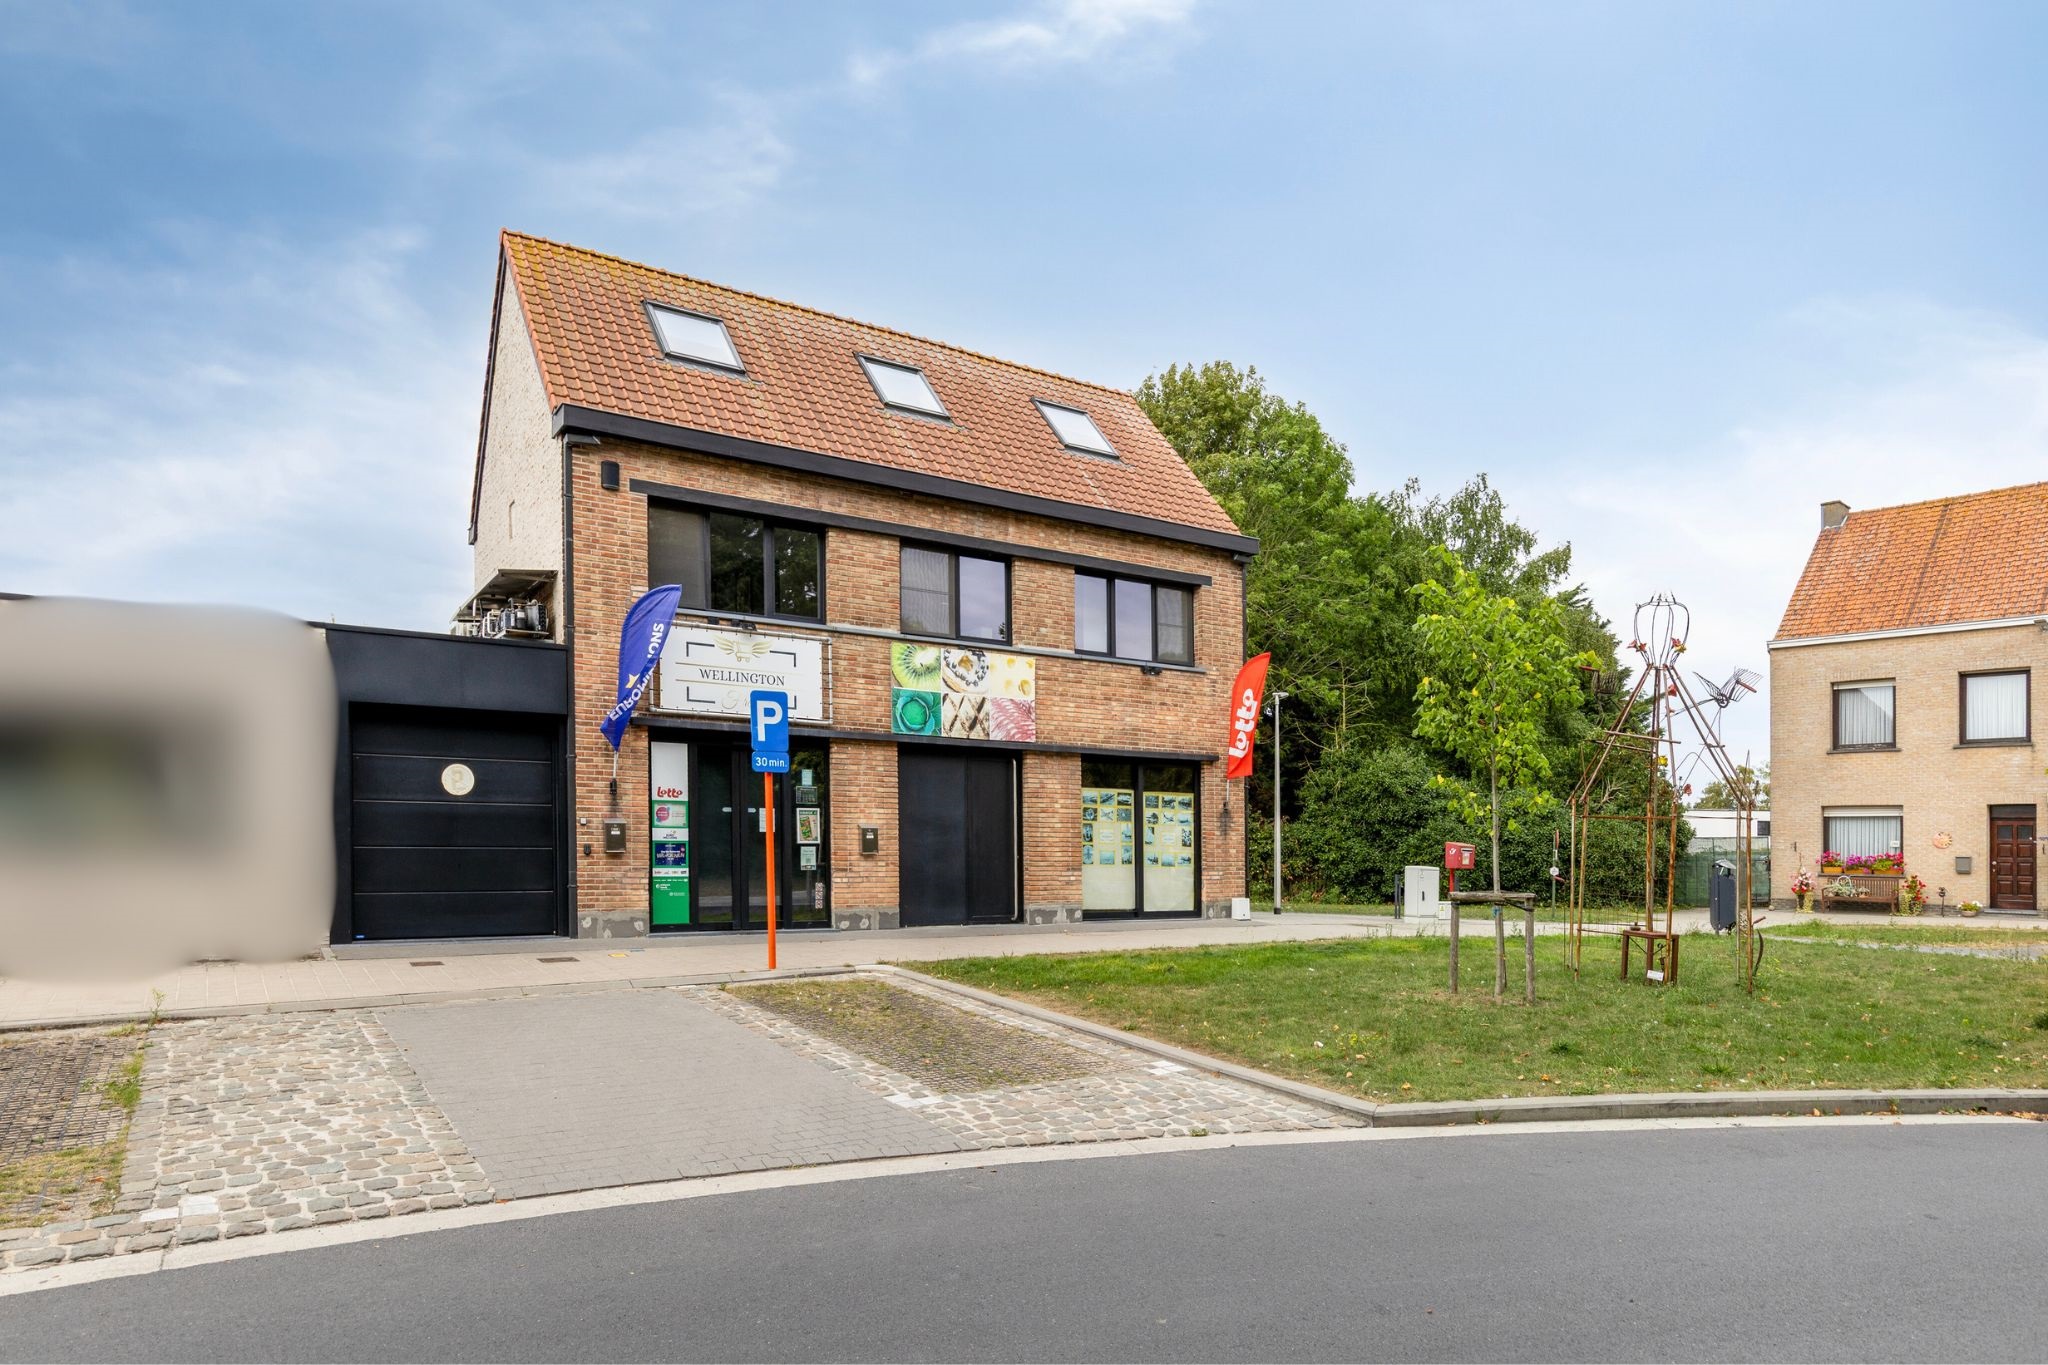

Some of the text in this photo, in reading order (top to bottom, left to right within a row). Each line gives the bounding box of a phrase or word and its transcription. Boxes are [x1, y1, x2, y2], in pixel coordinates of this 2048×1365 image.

[699, 668, 785, 686] WELLINGTON
[756, 700, 783, 742] P
[755, 757, 788, 768] 30 min.
